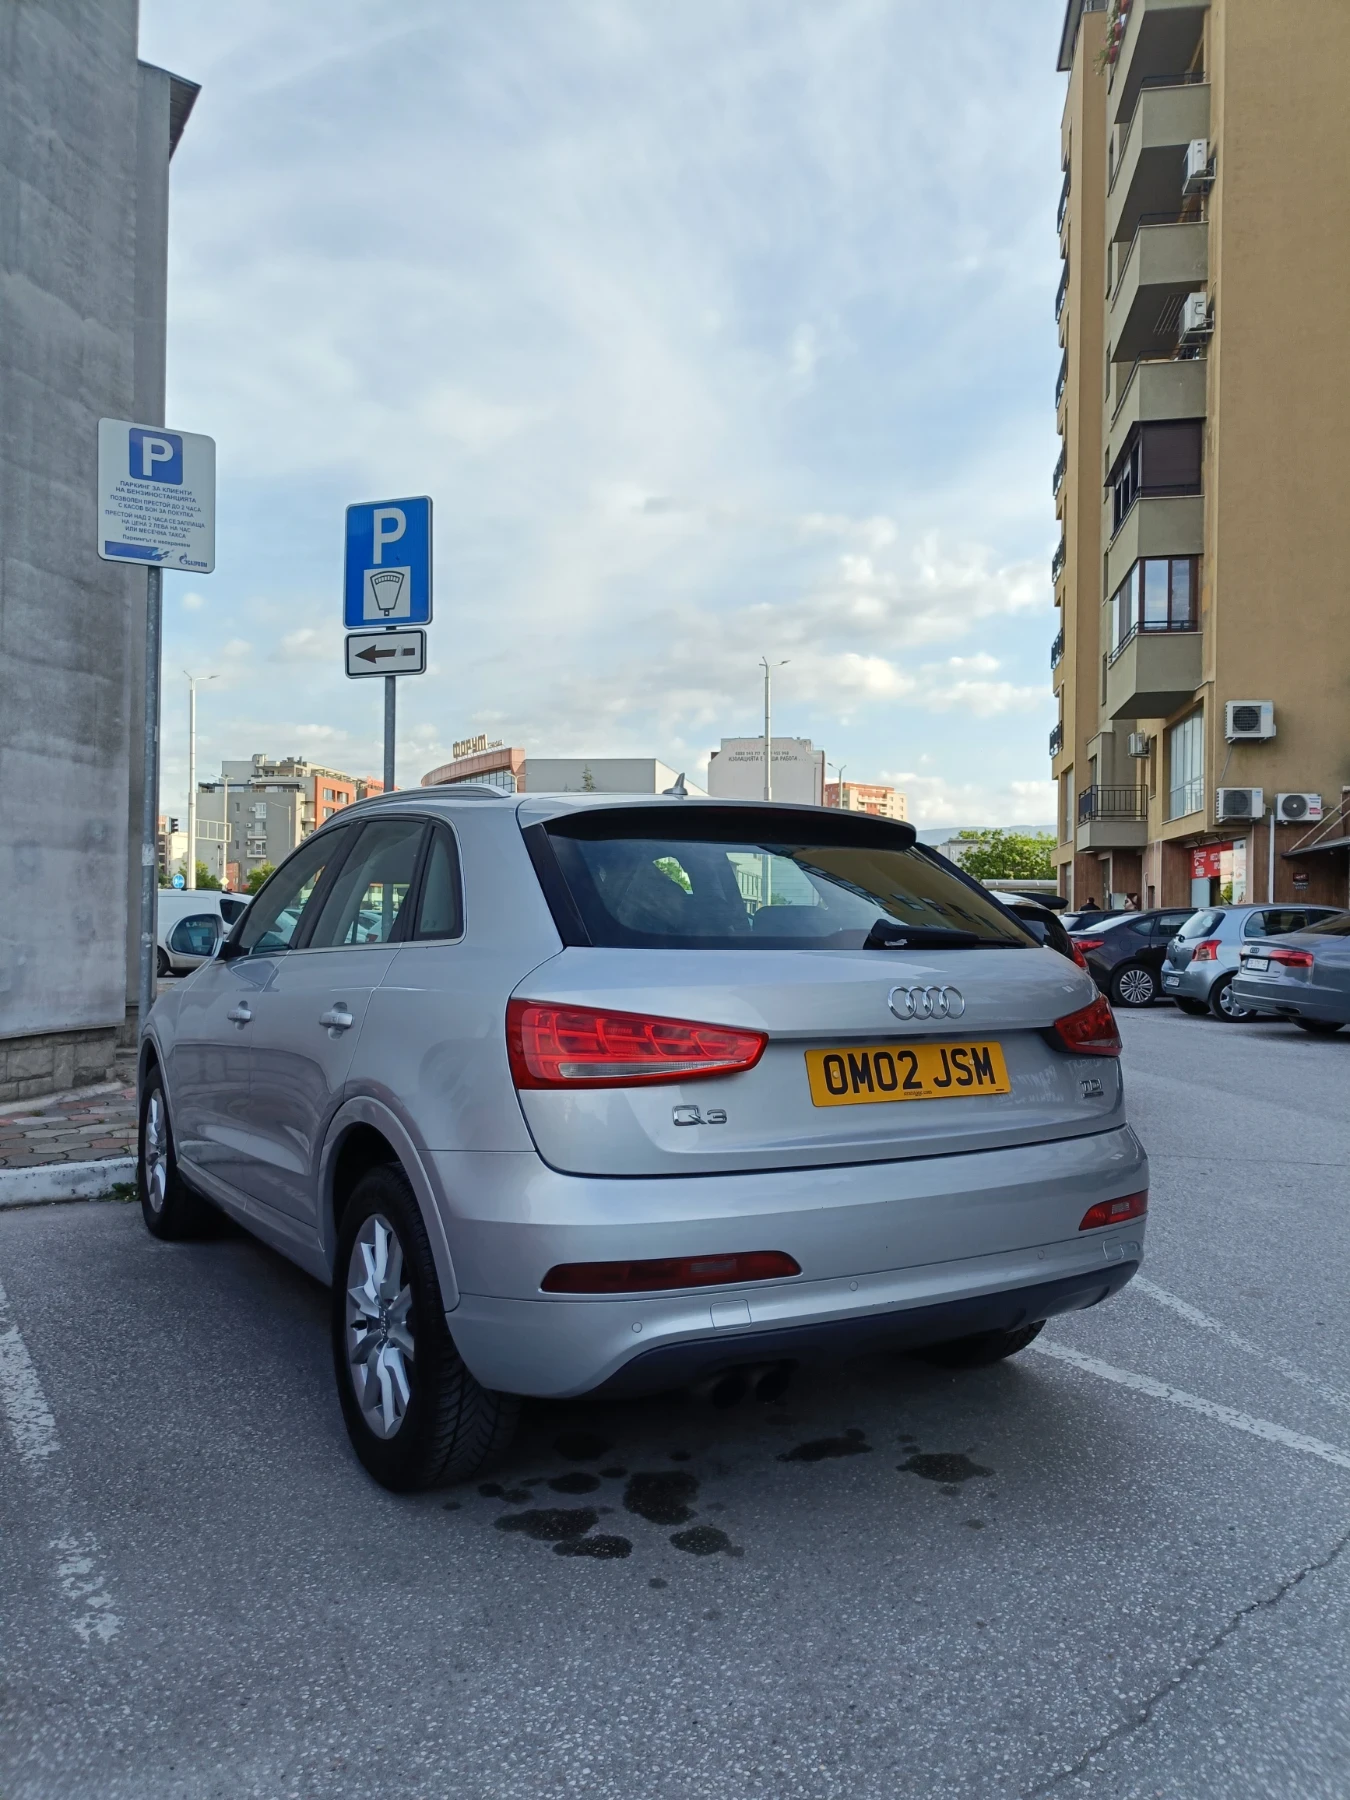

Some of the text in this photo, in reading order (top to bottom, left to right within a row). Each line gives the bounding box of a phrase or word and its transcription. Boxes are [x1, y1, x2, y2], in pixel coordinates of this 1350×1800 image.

[142, 436, 174, 477] P
[120, 480, 150, 490] ПАРКИНГ
[162, 487, 192, 496] КЛИЕНТИ
[126, 488, 196, 503] БЕНЗИНОСТАНЦИЯТА
[110, 494, 142, 504] ПОЗВОЛЕН
[144, 499, 170, 508] ПРЕСТОЙ
[105, 509, 133, 518] ПРЕСТОЙ
[177, 519, 205, 528] ЗАПЛАЩА
[168, 509, 194, 518] ПОКУПКА
[138, 528, 167, 536] МЕСЕЧНА
[373, 507, 406, 564] P
[933, 1046, 997, 1088] JSM
[672, 1105, 727, 1126] Q3
